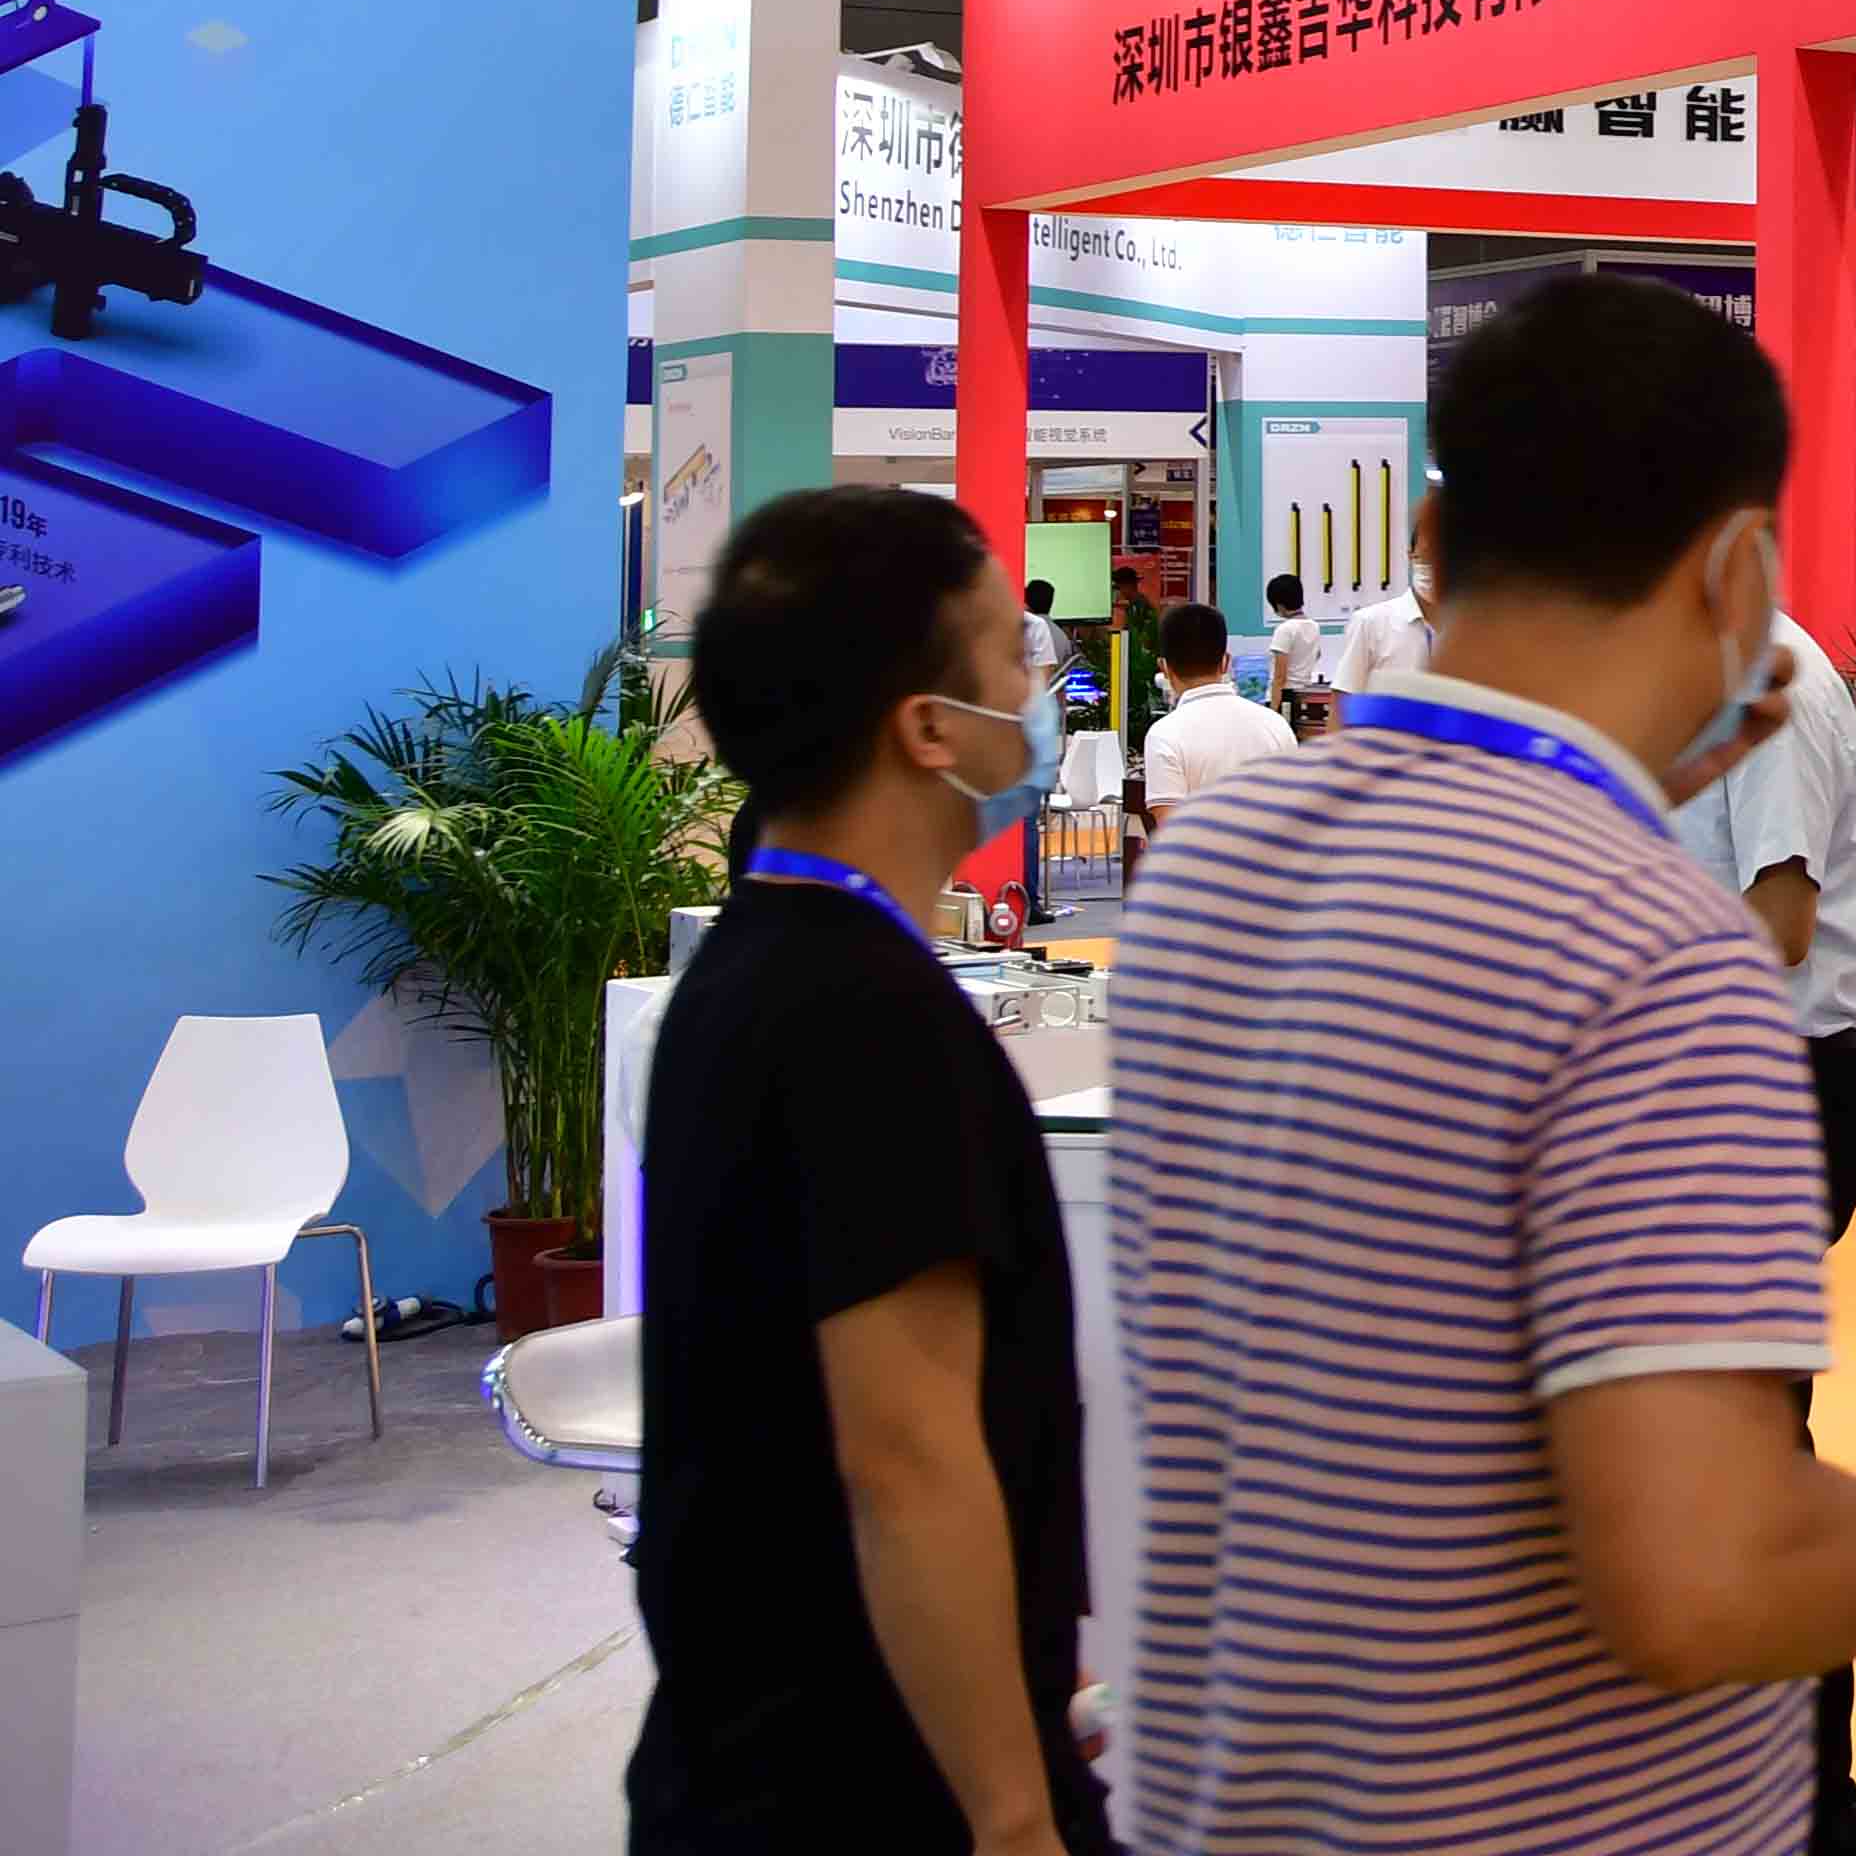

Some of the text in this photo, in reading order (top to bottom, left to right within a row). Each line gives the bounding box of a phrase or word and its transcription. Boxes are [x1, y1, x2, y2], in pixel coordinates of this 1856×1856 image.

[839, 180, 943, 231] Shenzhen
[1033, 216, 1112, 261] telligent
[1115, 230, 1146, 267] Co.,
[1152, 236, 1183, 271] Ltd.
